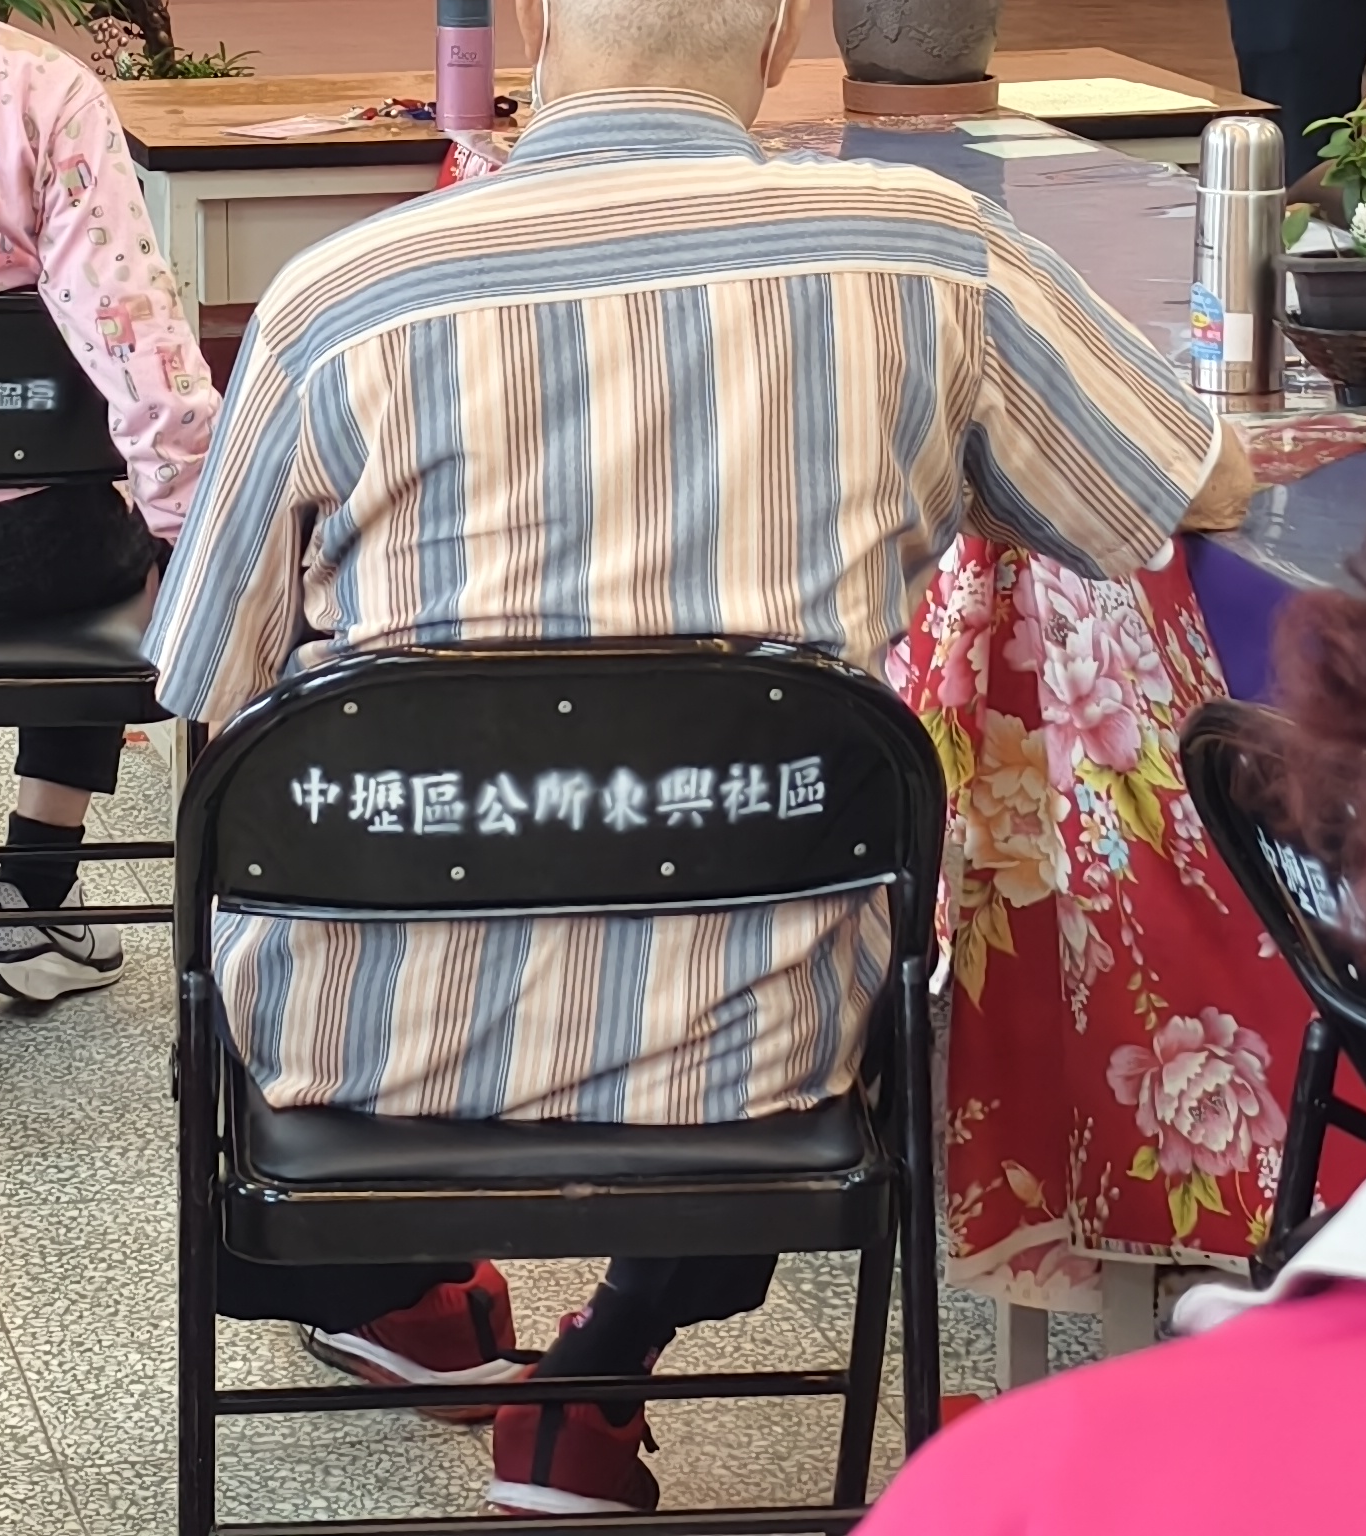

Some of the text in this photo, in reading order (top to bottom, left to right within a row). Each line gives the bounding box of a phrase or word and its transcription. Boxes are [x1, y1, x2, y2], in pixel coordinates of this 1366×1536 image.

[291, 756, 826, 836] 中壢區公所東興社區
